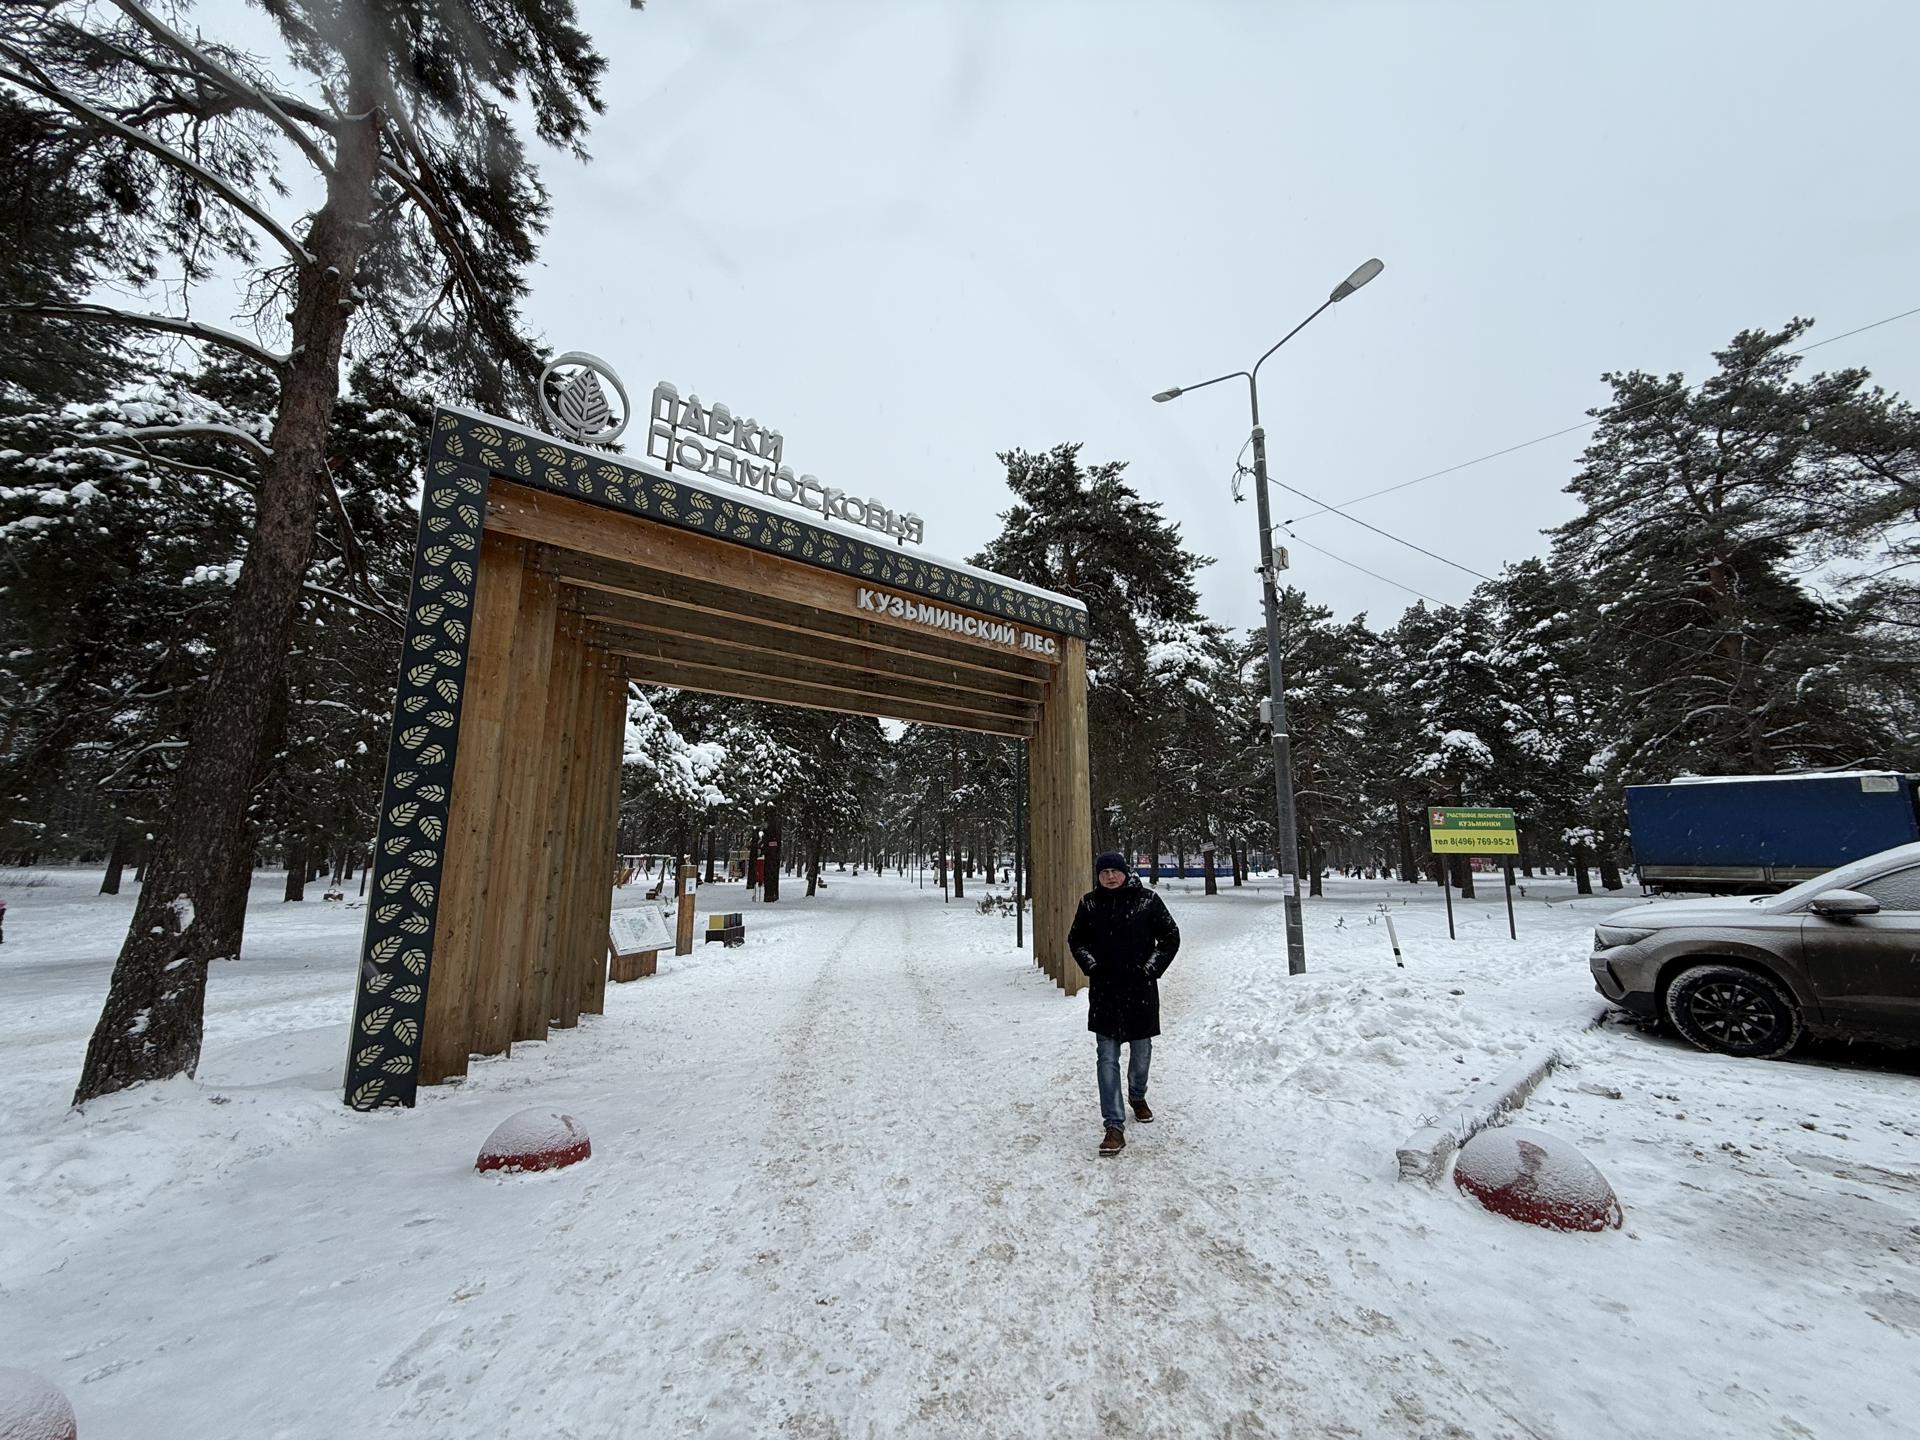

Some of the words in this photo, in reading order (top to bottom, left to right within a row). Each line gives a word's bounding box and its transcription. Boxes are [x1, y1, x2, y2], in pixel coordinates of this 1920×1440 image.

[651, 385, 784, 463] ПАРКИ
[647, 424, 925, 545] ПОДМОСКОВЬЯ
[857, 587, 1015, 646] КУЗЬМИНСКИЙ
[1020, 630, 1056, 655] ЛЕС
[1450, 837, 1475, 847] 8(496)
[1476, 837, 1515, 846] 769-95-21
